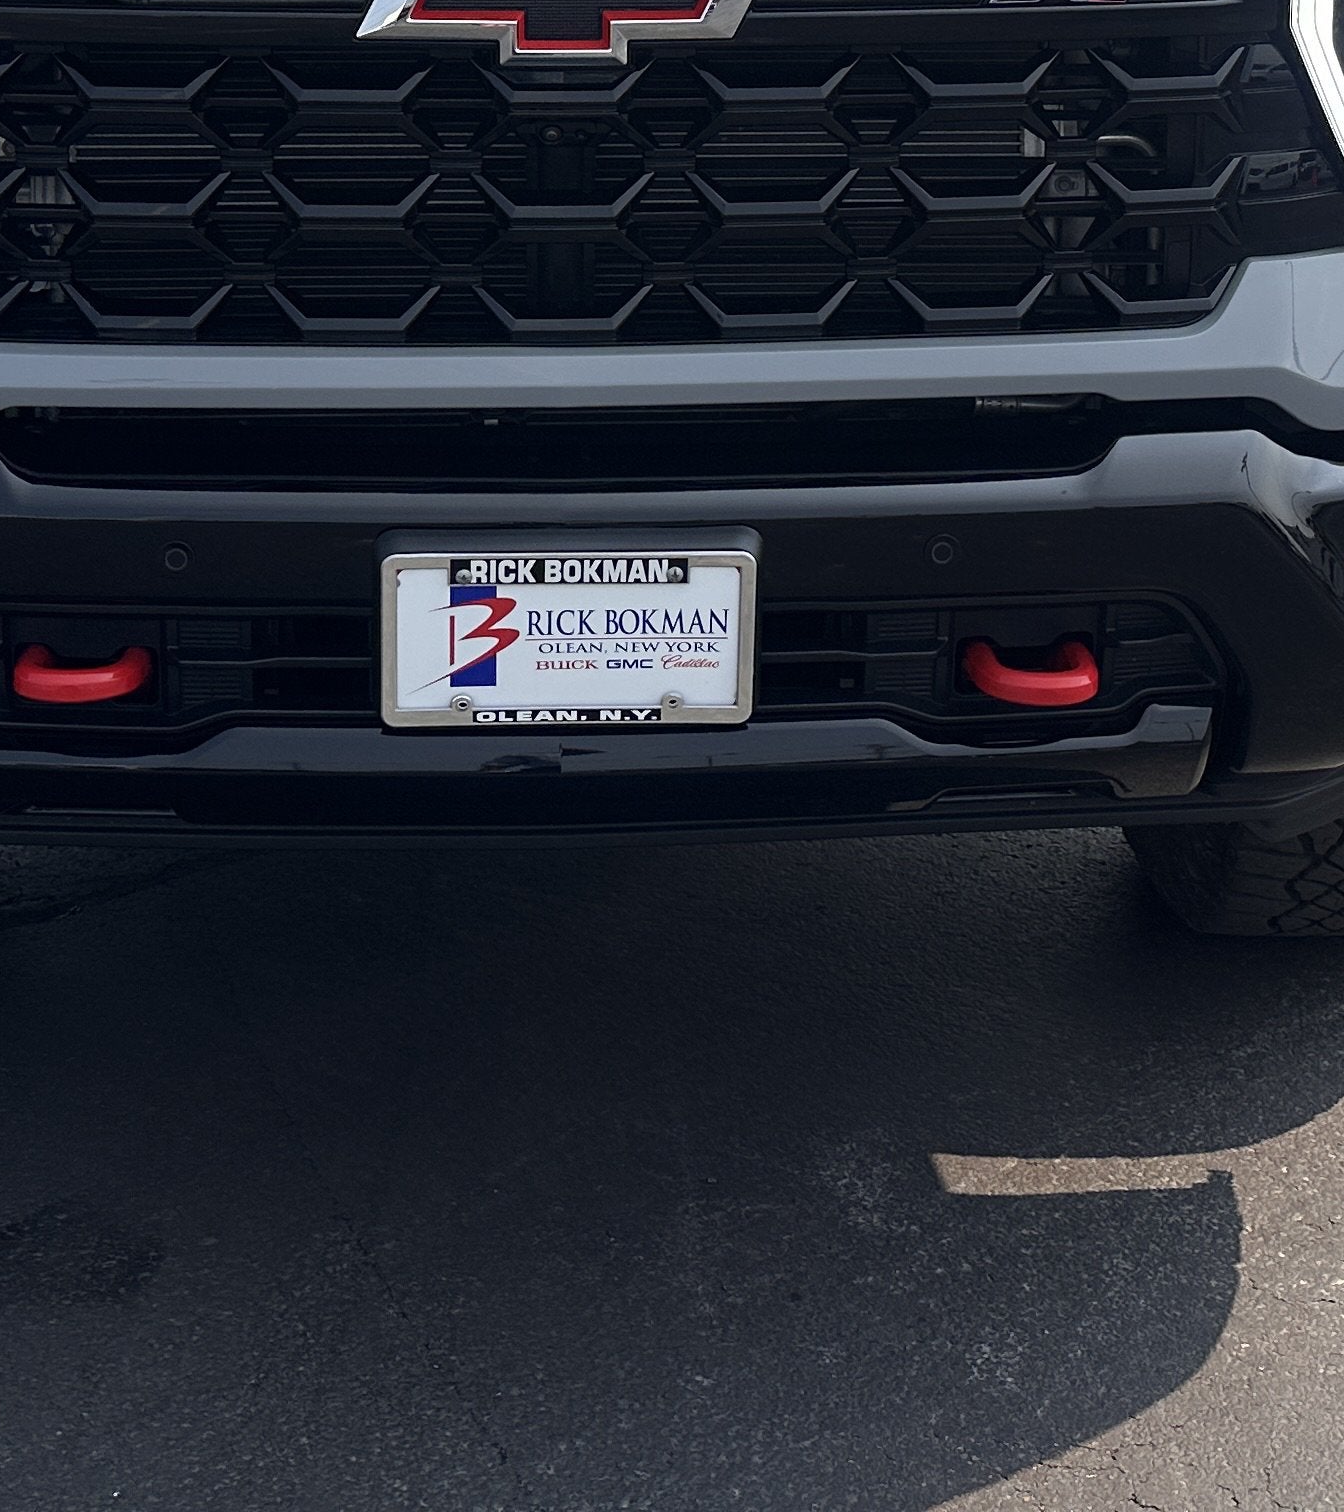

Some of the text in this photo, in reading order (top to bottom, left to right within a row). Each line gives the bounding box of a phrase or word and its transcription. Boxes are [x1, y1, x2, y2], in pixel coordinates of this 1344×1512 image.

[470, 559, 668, 583] RICK BOKMAN
[527, 607, 729, 635] RICK BOKMAN
[538, 641, 720, 654] OLEAN, NEW YORK
[535, 654, 720, 671] BUICK GMC Cadillac
[599, 710, 657, 721] N.Y.
